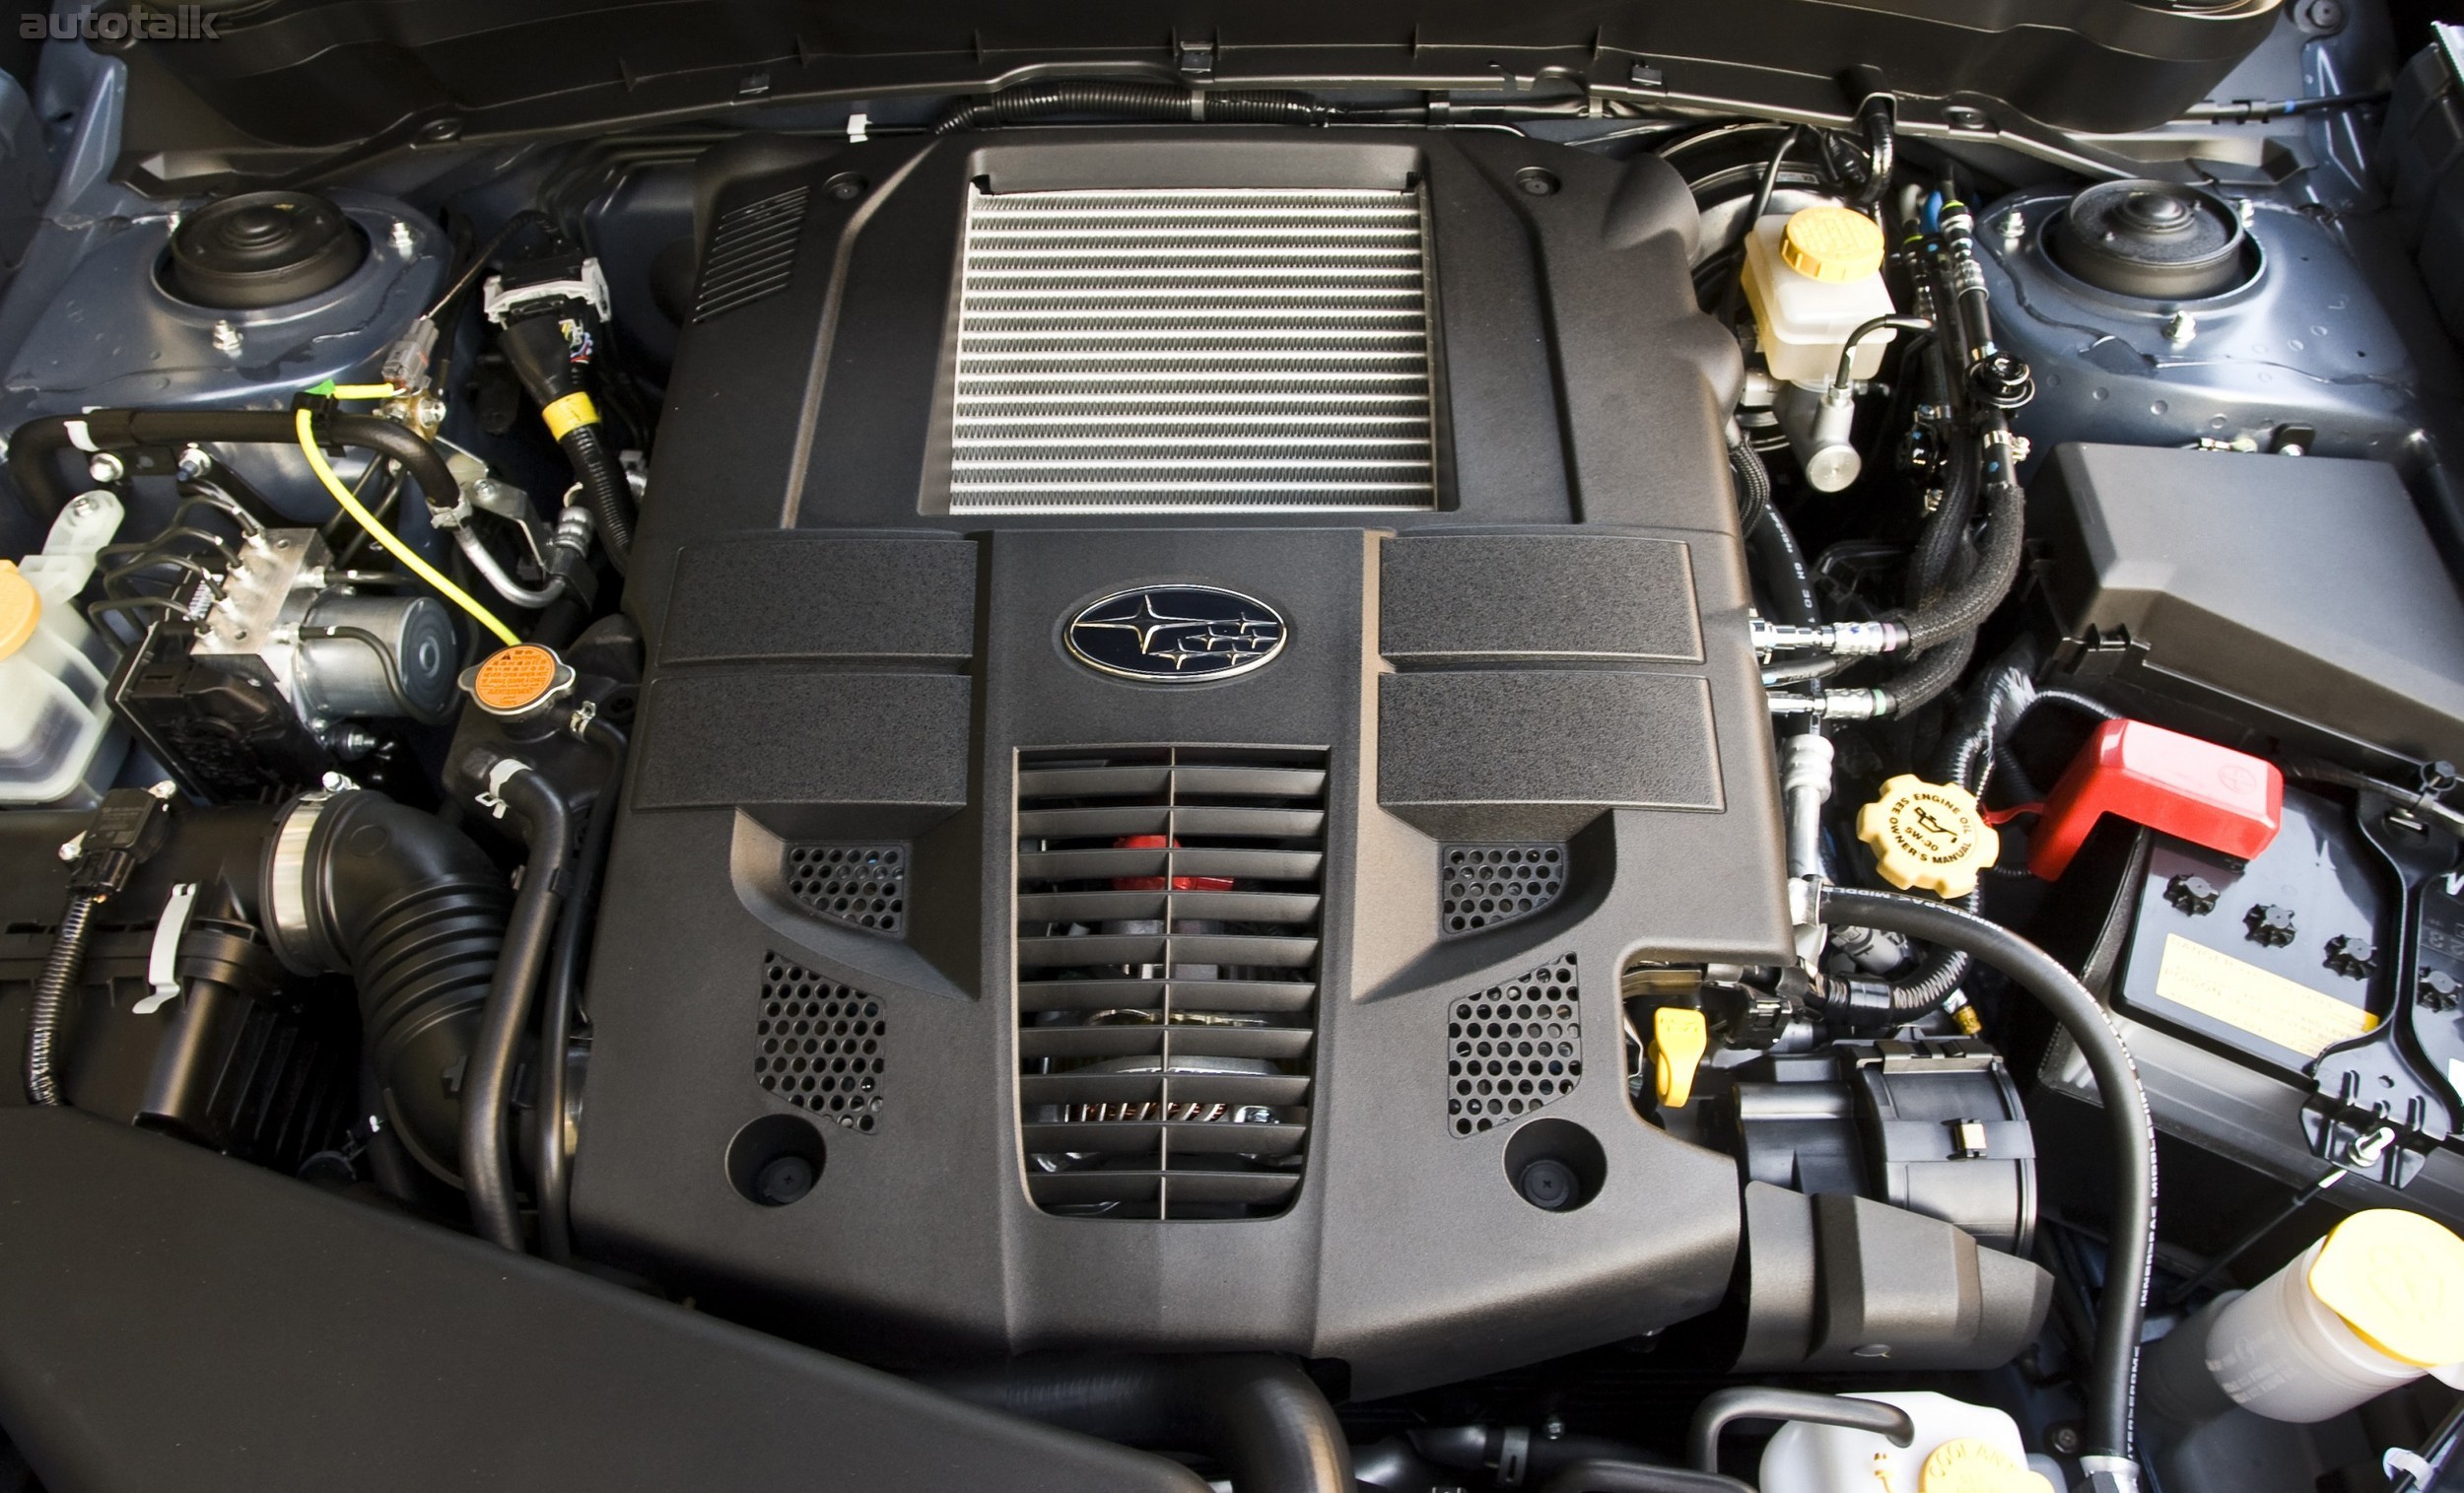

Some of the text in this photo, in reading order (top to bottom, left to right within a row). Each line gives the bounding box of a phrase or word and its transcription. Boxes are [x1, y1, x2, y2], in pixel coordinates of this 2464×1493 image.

[1888, 797, 1972, 864] SEE OWNER'S MANUAL
[1913, 793, 1972, 835] ENGINE OIL
[1904, 826, 1939, 852] 5W-30
